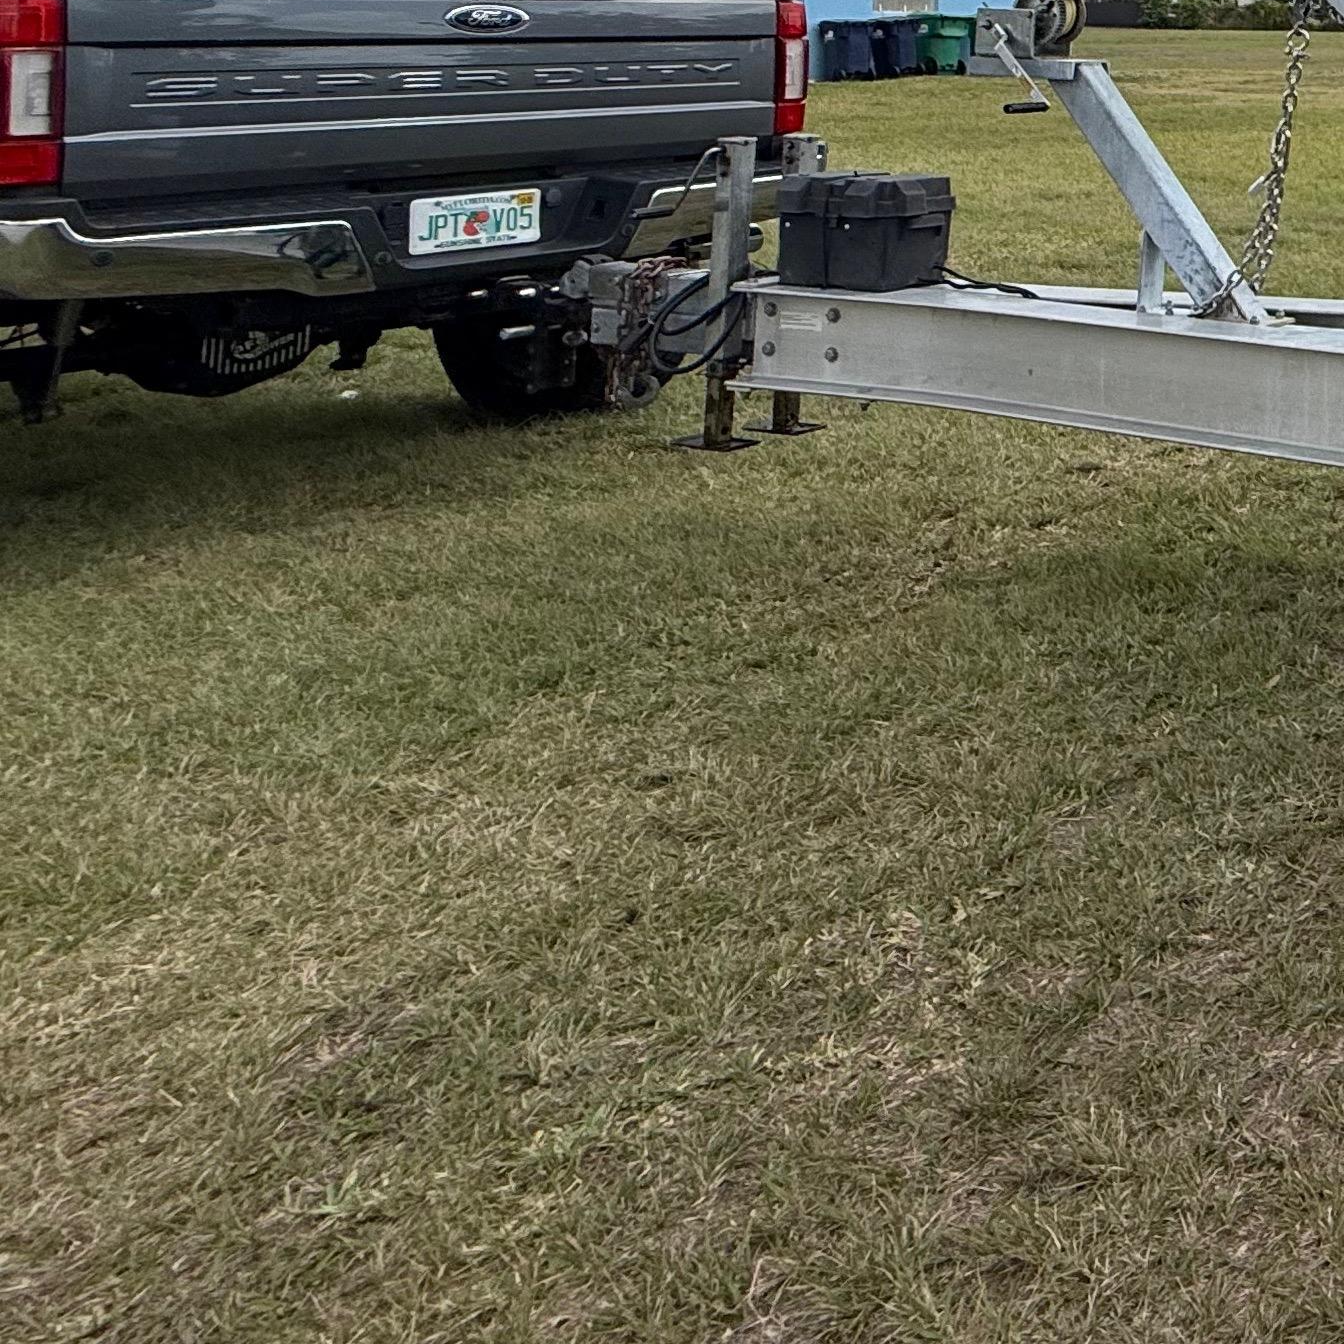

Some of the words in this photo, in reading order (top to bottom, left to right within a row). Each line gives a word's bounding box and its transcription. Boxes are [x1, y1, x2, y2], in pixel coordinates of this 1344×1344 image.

[146, 68, 509, 97] SUPER
[533, 62, 733, 86] DUTY
[418, 211, 465, 242] JPT
